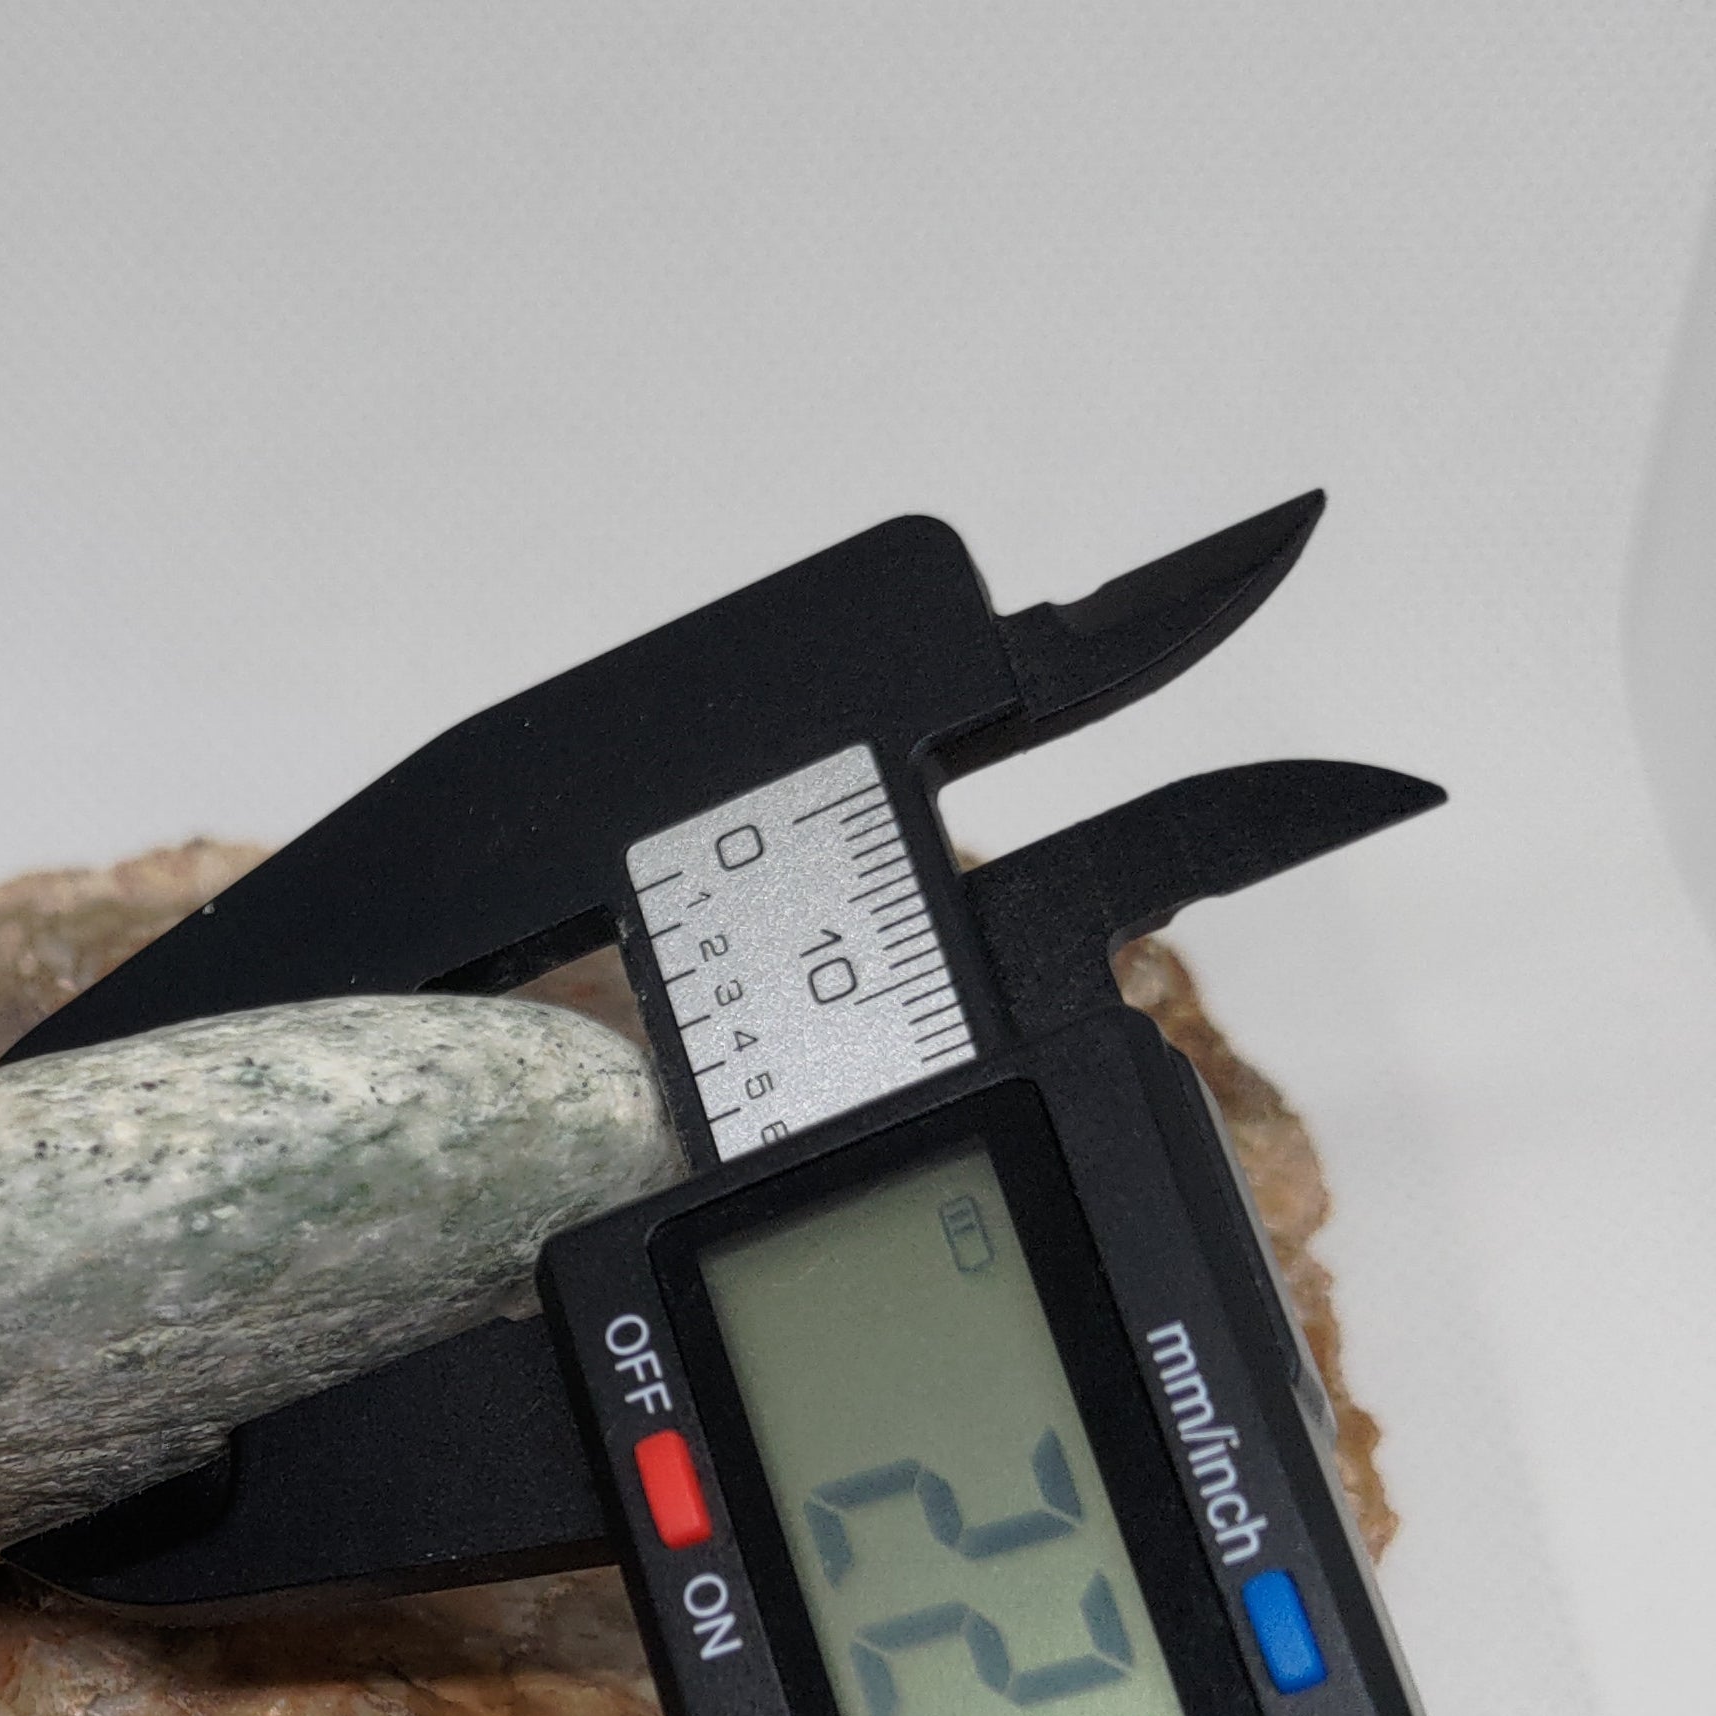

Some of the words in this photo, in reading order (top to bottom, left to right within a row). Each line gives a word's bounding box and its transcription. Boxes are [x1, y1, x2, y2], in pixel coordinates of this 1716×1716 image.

[686, 891, 712, 909] 1
[715, 823, 765, 872] 0
[799, 928, 858, 1005] 10
[699, 933, 730, 963] 2
[714, 979, 744, 1007] 3
[732, 1030, 759, 1054] 4
[744, 1071, 774, 1100] 5
[603, 1312, 675, 1416] OFF
[1145, 1319, 1267, 1566] mm/inch
[681, 1571, 744, 1662] ON
